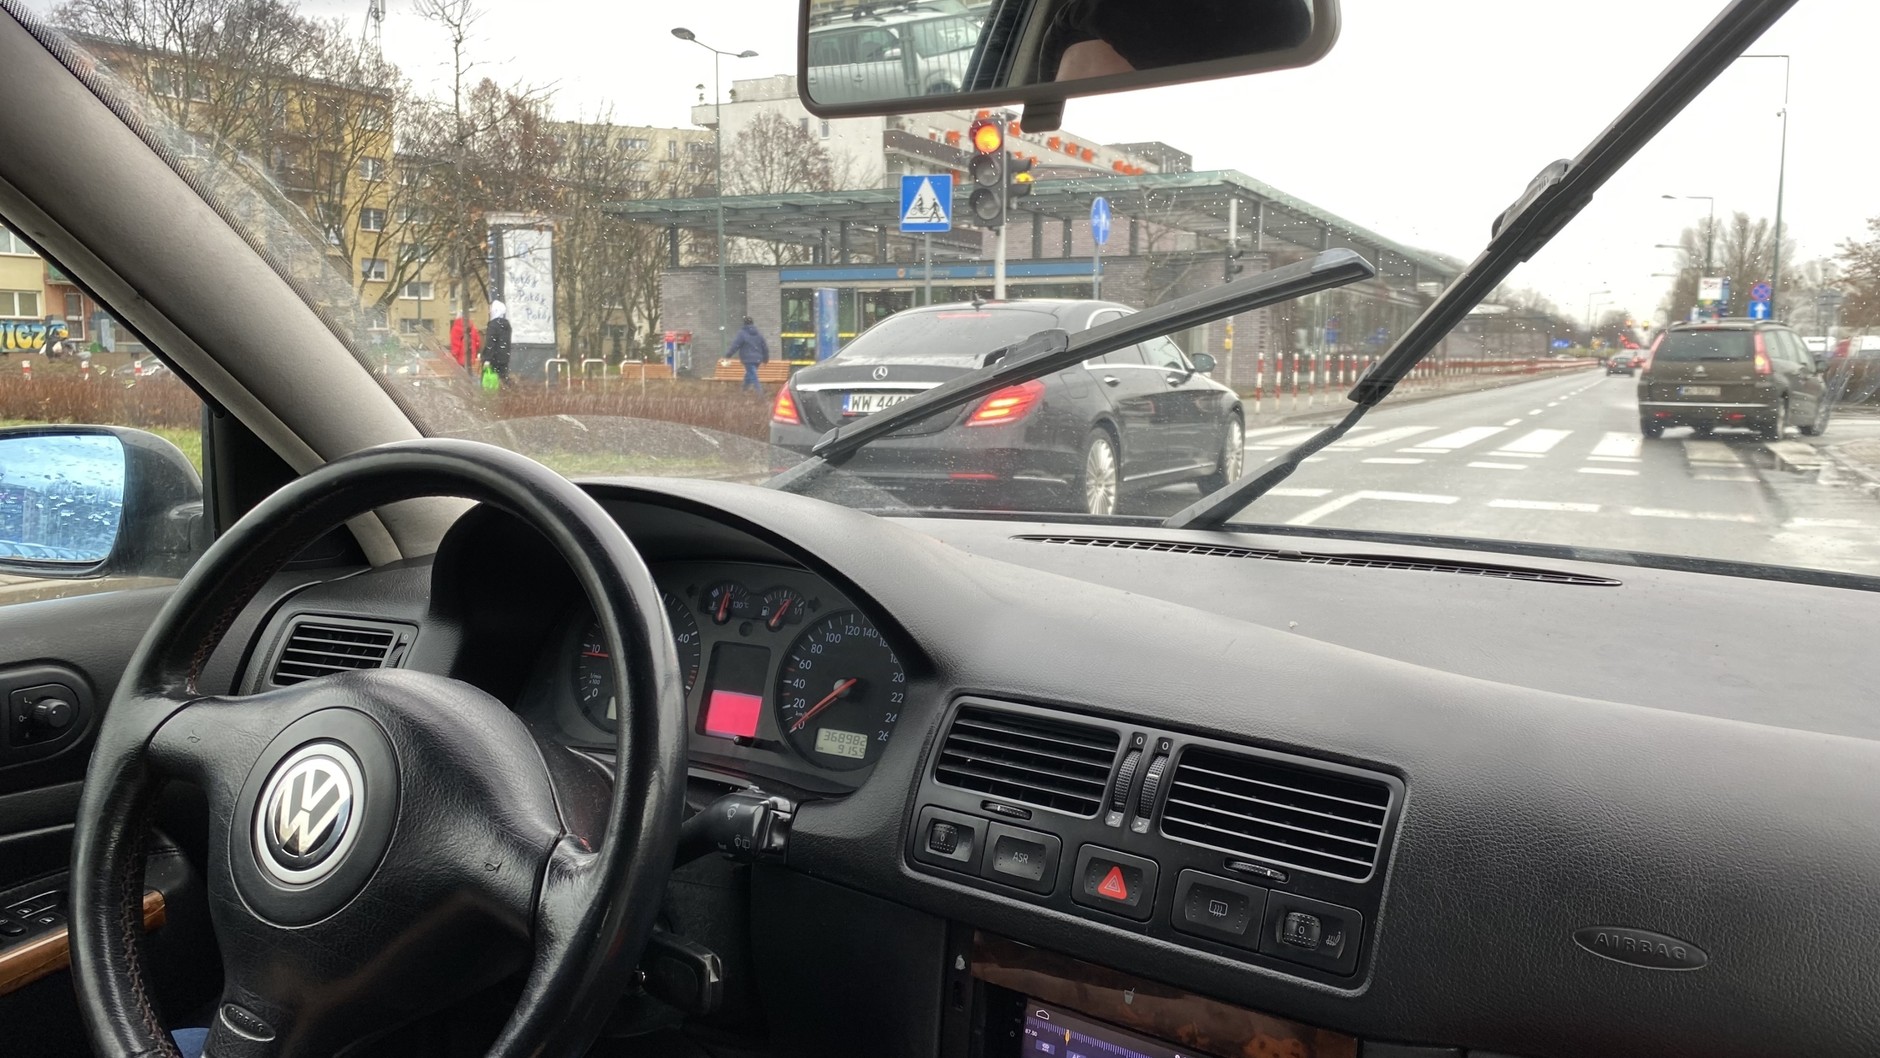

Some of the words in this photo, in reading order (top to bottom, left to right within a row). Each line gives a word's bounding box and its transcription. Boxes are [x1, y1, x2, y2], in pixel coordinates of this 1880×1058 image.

[851, 396, 872, 411] WW
[845, 625, 861, 636] 120
[863, 627, 879, 639] 140
[678, 633, 690, 644] 40
[825, 632, 842, 644] 100
[592, 644, 601, 654] 10
[810, 644, 823, 654] 80
[799, 660, 812, 670] 60
[891, 672, 905, 683] 20
[792, 679, 806, 689] 40
[592, 688, 599, 698] 0
[891, 692, 904, 704] 22
[793, 698, 806, 709] 20
[823, 731, 867, 747] 368982
[1136, 736, 1144, 745] 0
[1162, 741, 1169, 750] 0
[1012, 851, 1029, 864] ASR
[1594, 932, 1687, 960] AIRBAG
